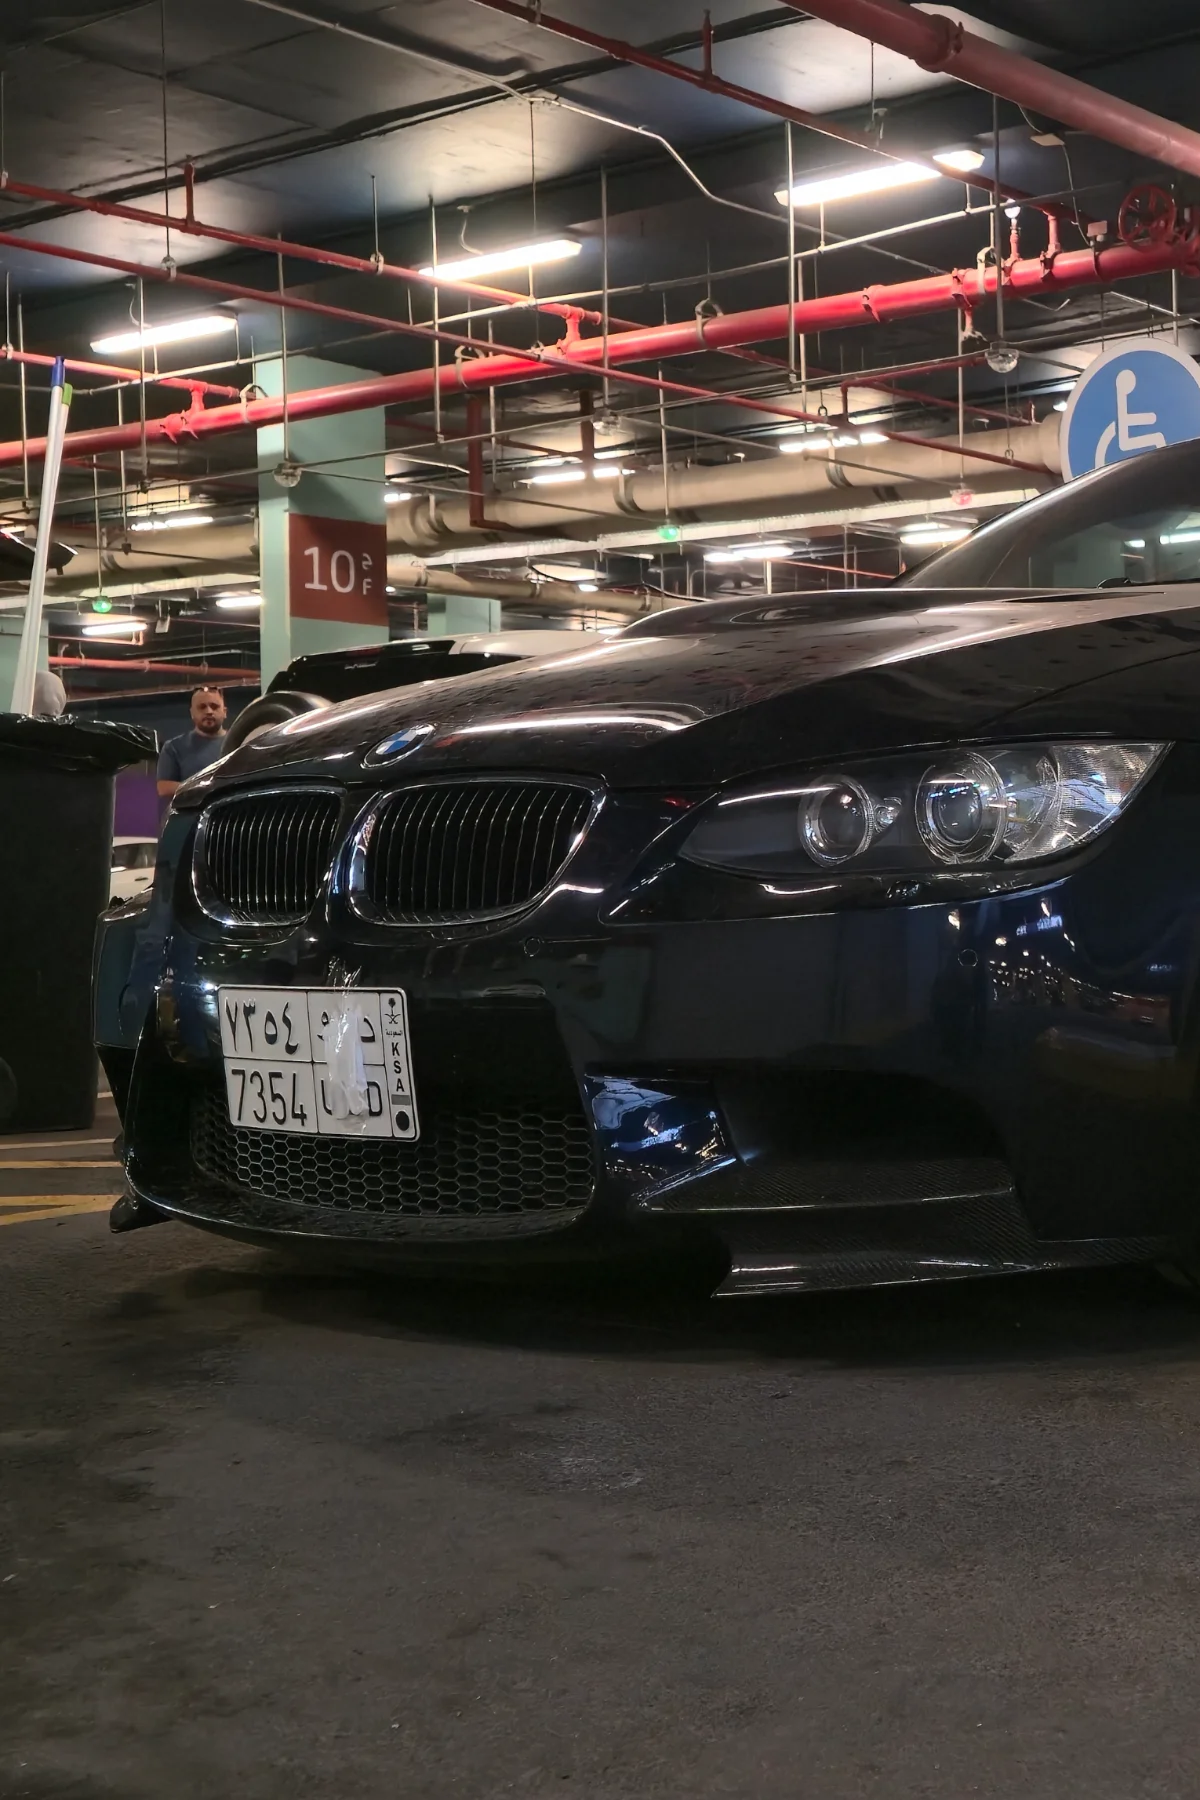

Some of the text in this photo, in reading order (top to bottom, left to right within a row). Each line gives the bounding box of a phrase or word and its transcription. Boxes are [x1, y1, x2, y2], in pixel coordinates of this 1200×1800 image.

[304, 546, 356, 593] 10
[362, 578, 373, 595] F
[231, 1068, 308, 1127] 7354
